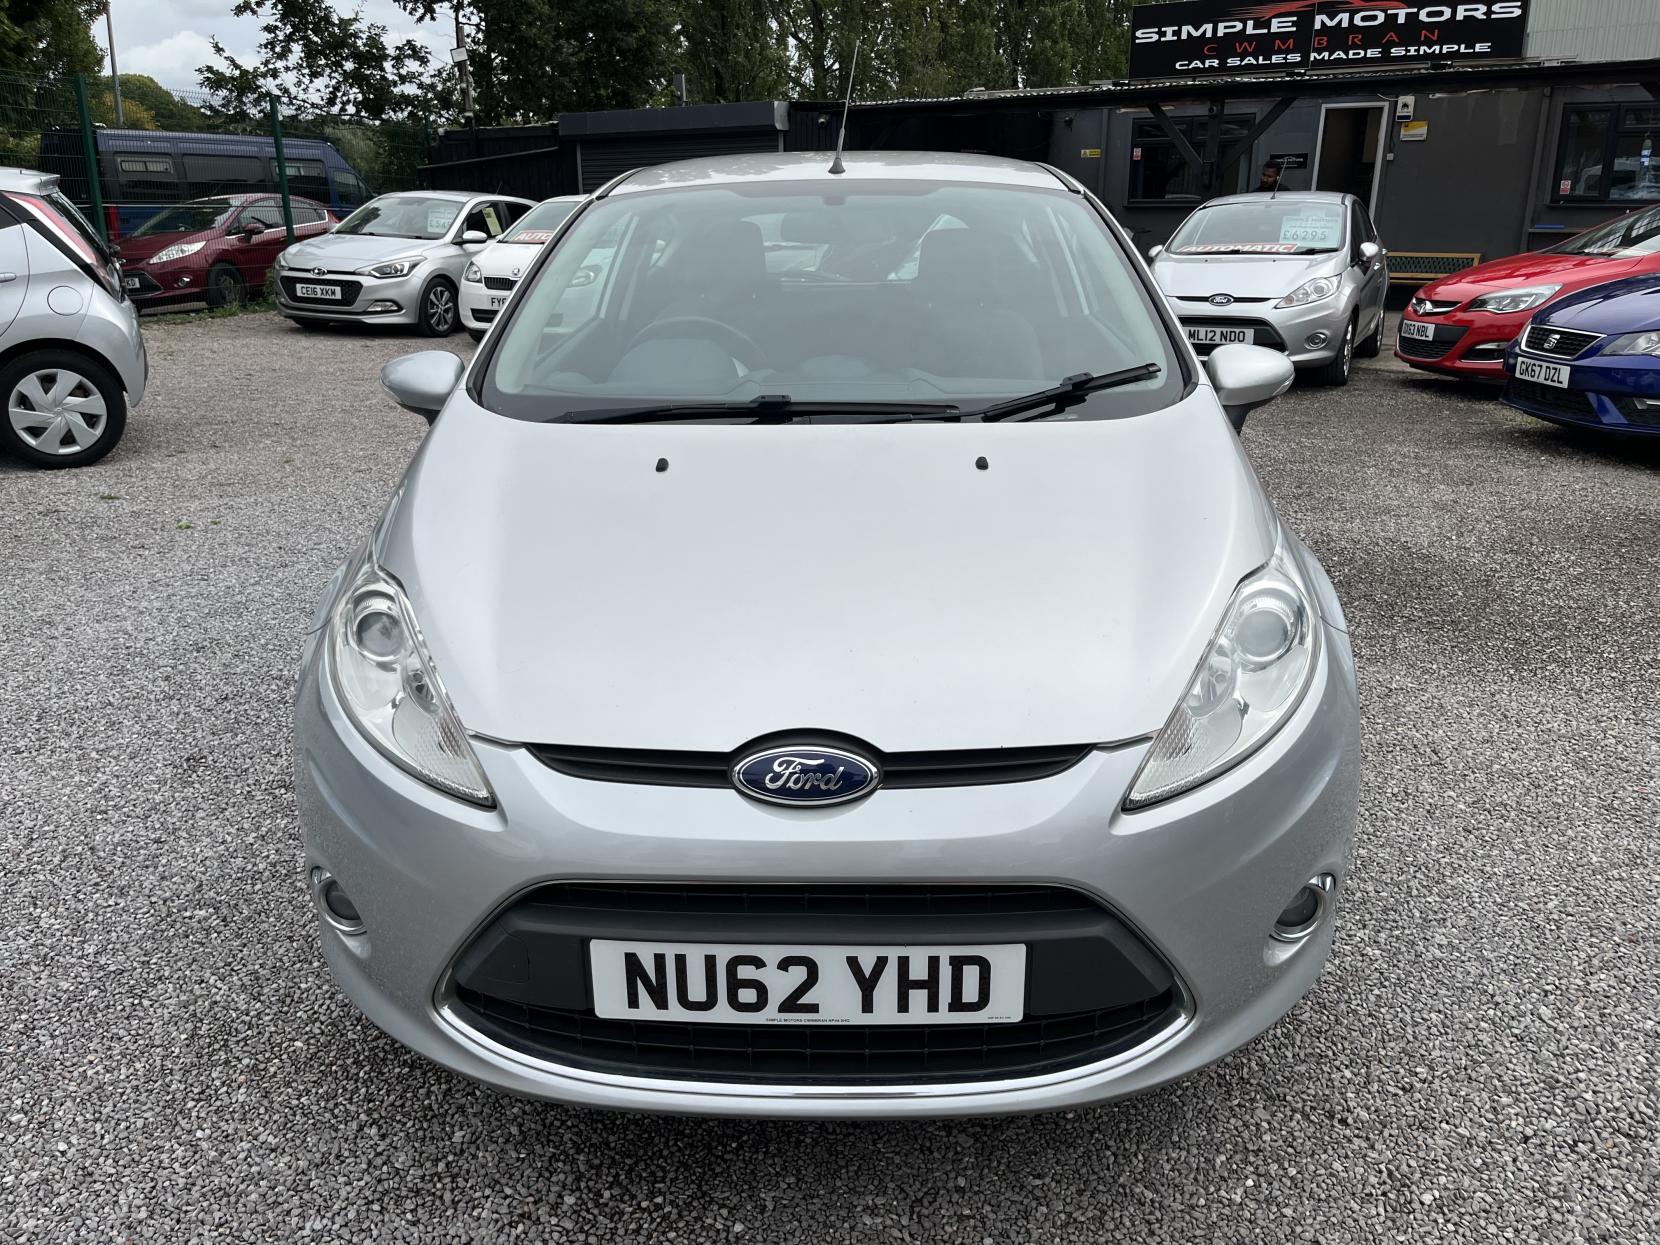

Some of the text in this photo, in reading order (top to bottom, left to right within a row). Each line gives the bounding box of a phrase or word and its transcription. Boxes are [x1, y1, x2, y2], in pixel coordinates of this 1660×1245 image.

[1135, 1, 1522, 44] SIMPLE MOTORS
[1203, 29, 1440, 56] CWMBRAN
[1175, 42, 1492, 70] CAR SALES MADE SIMPLE
[1181, 243, 1294, 252] AUTOMATIC
[1282, 230, 1328, 241] £6295
[300, 285, 337, 298] CE16 XKM
[1188, 329, 1246, 343] ML12 NDO
[1415, 324, 1430, 338] NBL
[1519, 360, 1564, 385] GK67 DZL
[764, 756, 845, 791] Ford
[623, 951, 992, 1015] NU62 YHD
